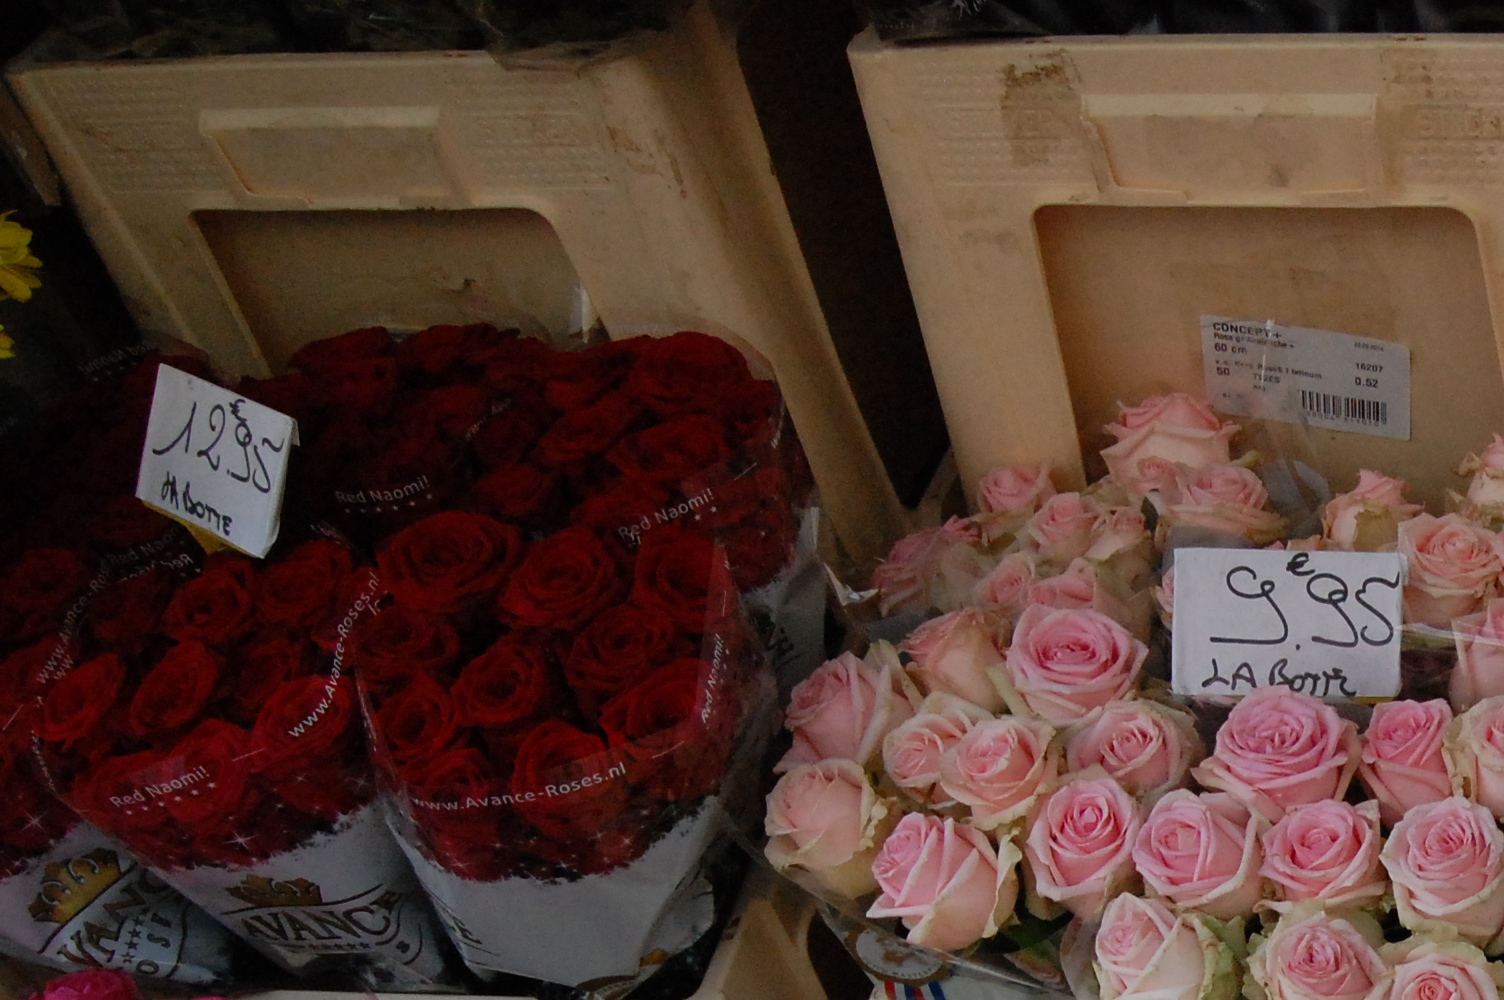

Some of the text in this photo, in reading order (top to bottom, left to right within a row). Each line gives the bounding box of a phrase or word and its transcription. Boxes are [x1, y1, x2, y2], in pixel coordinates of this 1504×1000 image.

[1213, 322, 1269, 338] CONCEPT
[1214, 343, 1248, 355] 60 cm
[1216, 367, 1231, 377] 50
[1355, 362, 1384, 373] 16207
[1354, 377, 1379, 388] 0.52
[335, 475, 431, 503] Red Naomi!
[654, 487, 714, 524] Naomi!
[288, 571, 380, 738] www.Avance-Roses.nl
[1202, 658, 1257, 691] LA
[109, 764, 211, 808] Red Naomi!
[411, 761, 628, 812] www.Avance-Roses.nl
